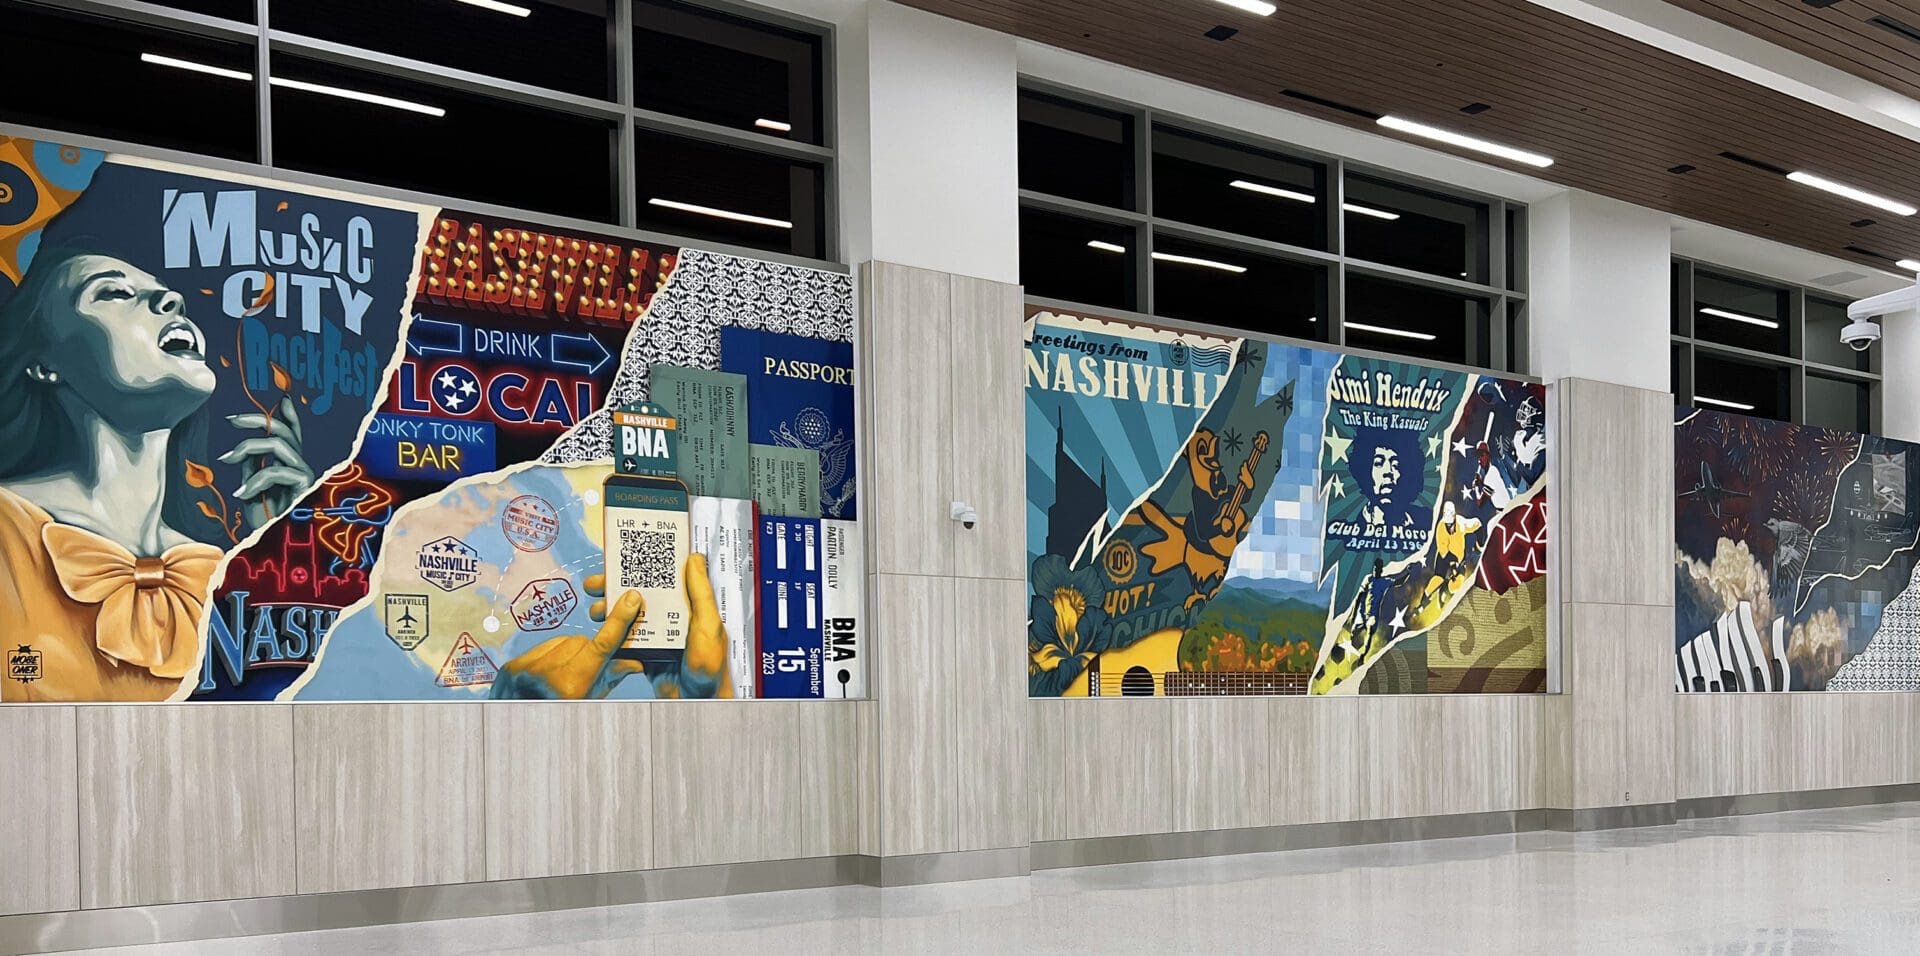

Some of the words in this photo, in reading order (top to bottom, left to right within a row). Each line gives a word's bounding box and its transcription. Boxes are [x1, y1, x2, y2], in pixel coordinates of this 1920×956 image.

[222, 270, 374, 335] CITY
[474, 328, 543, 359] DRINK
[1106, 342, 1149, 361] from
[763, 356, 856, 387] PASSPORT
[1330, 369, 1372, 405] Jimi
[1375, 372, 1450, 412] Hendrix
[623, 413, 668, 428] NASHVILLE
[725, 386, 736, 437] CASH/JOHNNY
[1339, 408, 1361, 426] The
[1363, 411, 1389, 430] King
[1390, 414, 1429, 431] Kasuals
[429, 422, 484, 444] TONK
[621, 425, 670, 459] BNA
[398, 441, 461, 471] BAR
[615, 492, 658, 505] BOARDING
[660, 494, 679, 505] PASS
[507, 513, 534, 527] MUSIC
[535, 523, 555, 533] CITY
[616, 518, 636, 529] LHR
[656, 520, 678, 531] BNA
[1327, 521, 1361, 537] Club
[1363, 523, 1388, 538] Del
[1346, 537, 1380, 550] April
[1384, 539, 1398, 550] 13
[419, 554, 478, 573] NASHVILLE
[426, 569, 447, 580] MUSIC
[454, 572, 471, 582] CITY
[827, 564, 838, 590] DOLLY
[387, 597, 428, 606] NASHVILLE
[805, 583, 815, 599] SEAT
[516, 589, 574, 625] NASHVILLE
[823, 619, 832, 662] NASHVILLE
[832, 617, 856, 663] BNA
[762, 652, 775, 675] 2023
[778, 646, 806, 673] 15
[808, 647, 820, 696] September
